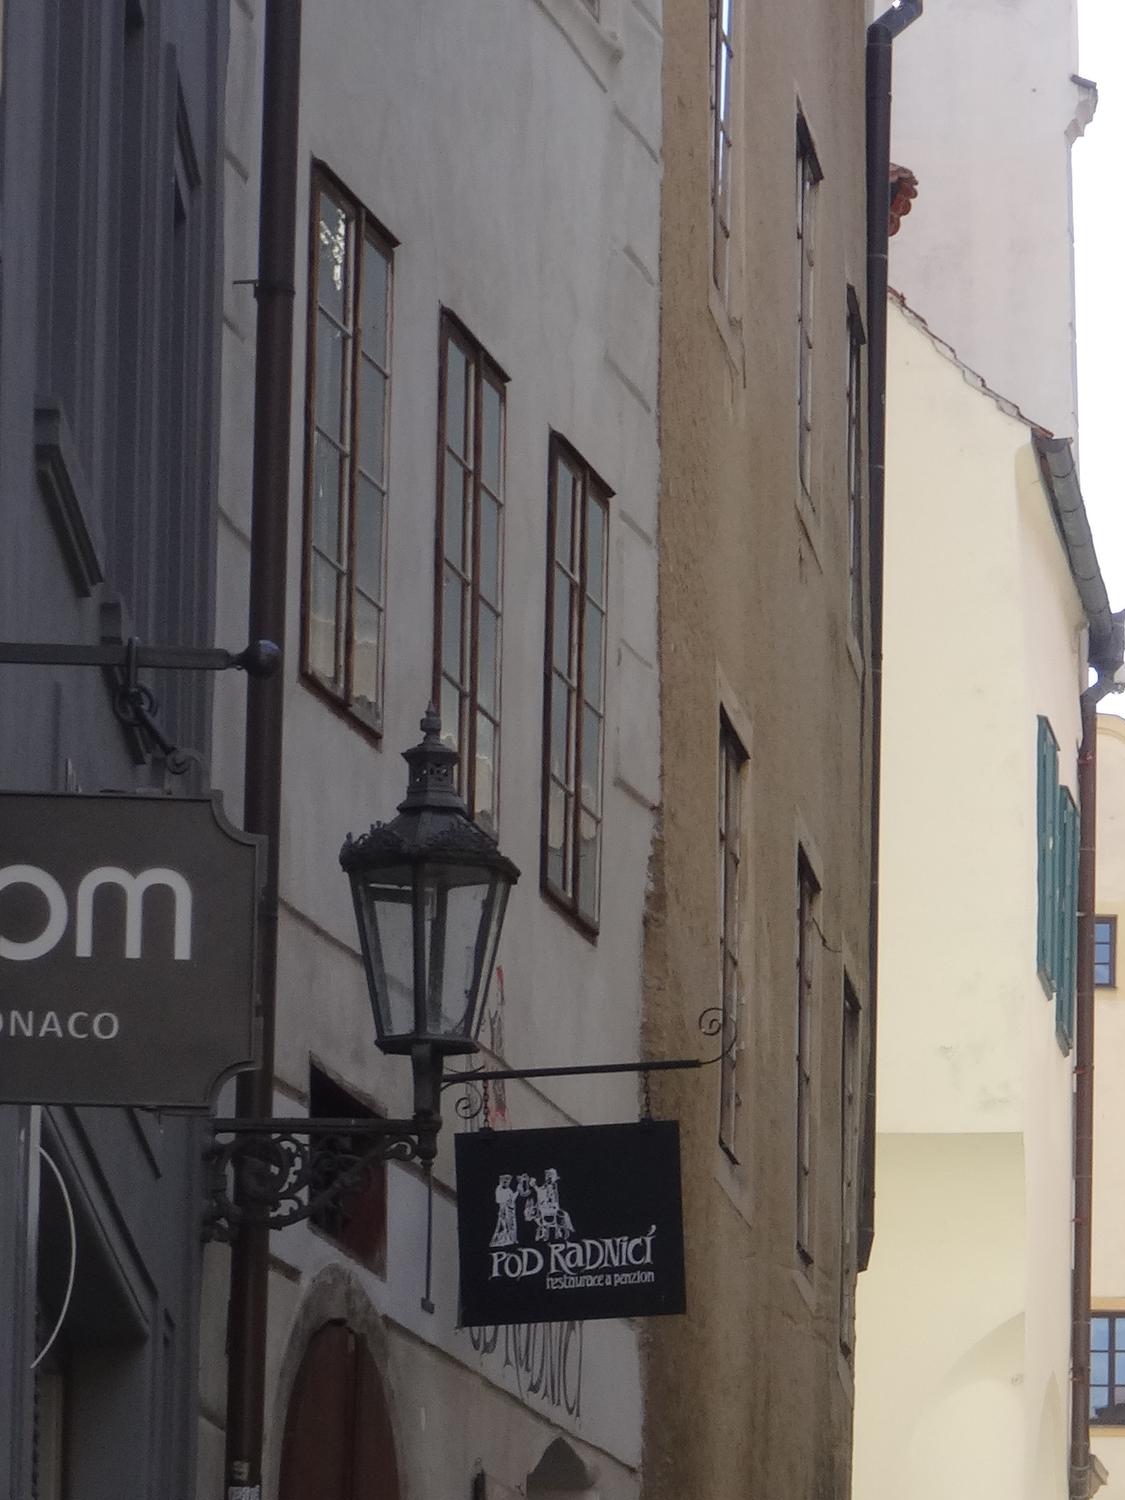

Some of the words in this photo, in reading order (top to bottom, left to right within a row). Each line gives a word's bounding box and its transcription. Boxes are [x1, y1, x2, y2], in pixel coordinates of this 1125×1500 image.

[0, 1010, 120, 1039] NACO
[489, 1248, 545, 1280] POD
[546, 1273, 604, 1290] restaurace
[605, 1276, 612, 1287] a
[613, 1271, 655, 1286] penzion
